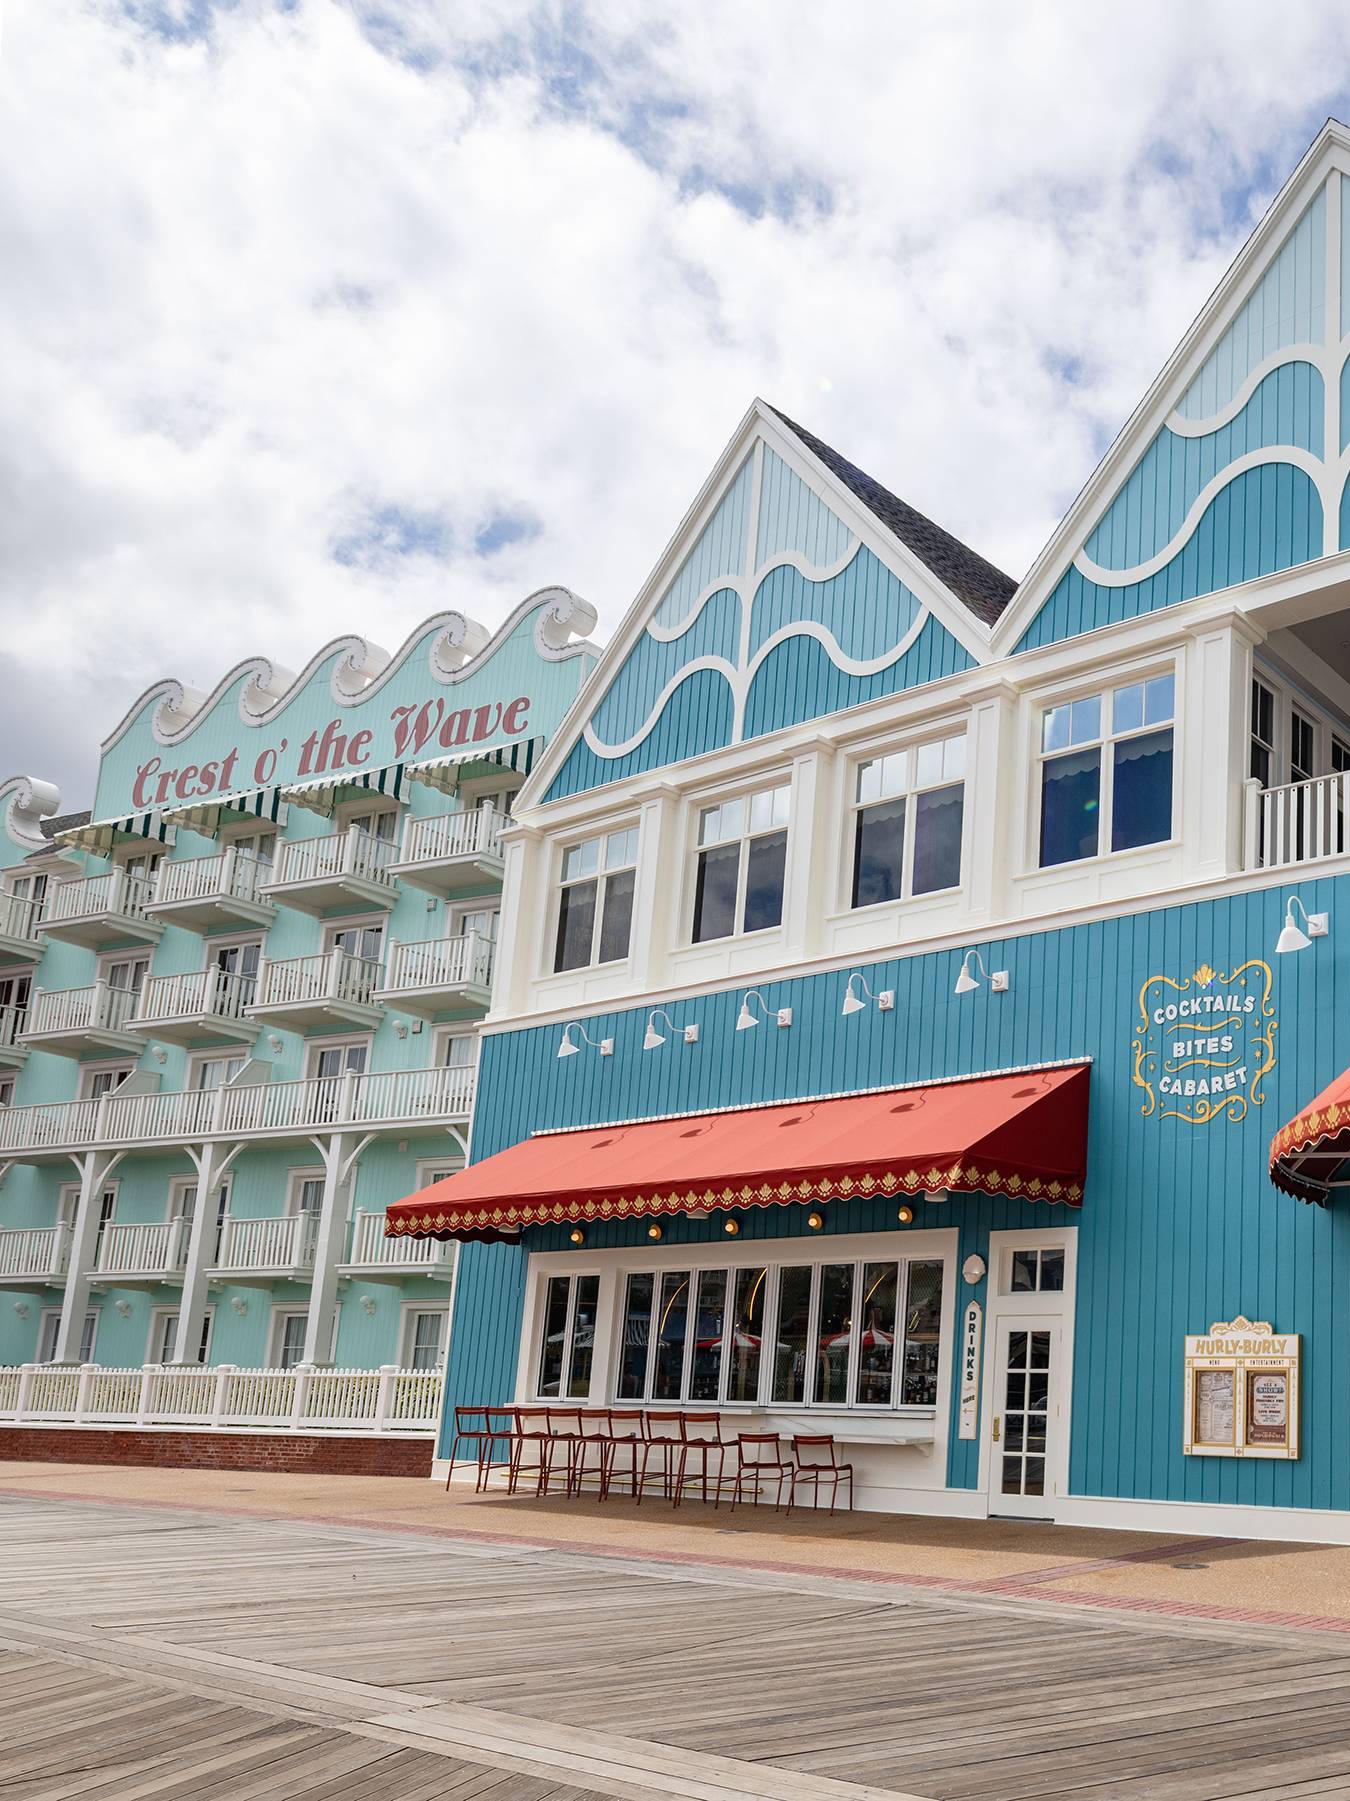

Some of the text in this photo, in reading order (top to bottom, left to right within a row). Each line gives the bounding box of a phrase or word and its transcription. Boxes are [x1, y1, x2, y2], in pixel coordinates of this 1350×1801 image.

[132, 746, 239, 809] Crest
[297, 718, 373, 776] the
[390, 696, 531, 759] Wave
[1153, 995, 1255, 1025] COCKTAILS
[1173, 1035, 1233, 1058] BITES
[1159, 1066, 1247, 1097] CABARET
[966, 1311, 977, 1381] DRINKS
[1195, 1338, 1288, 1355] HURLY-BURLY
